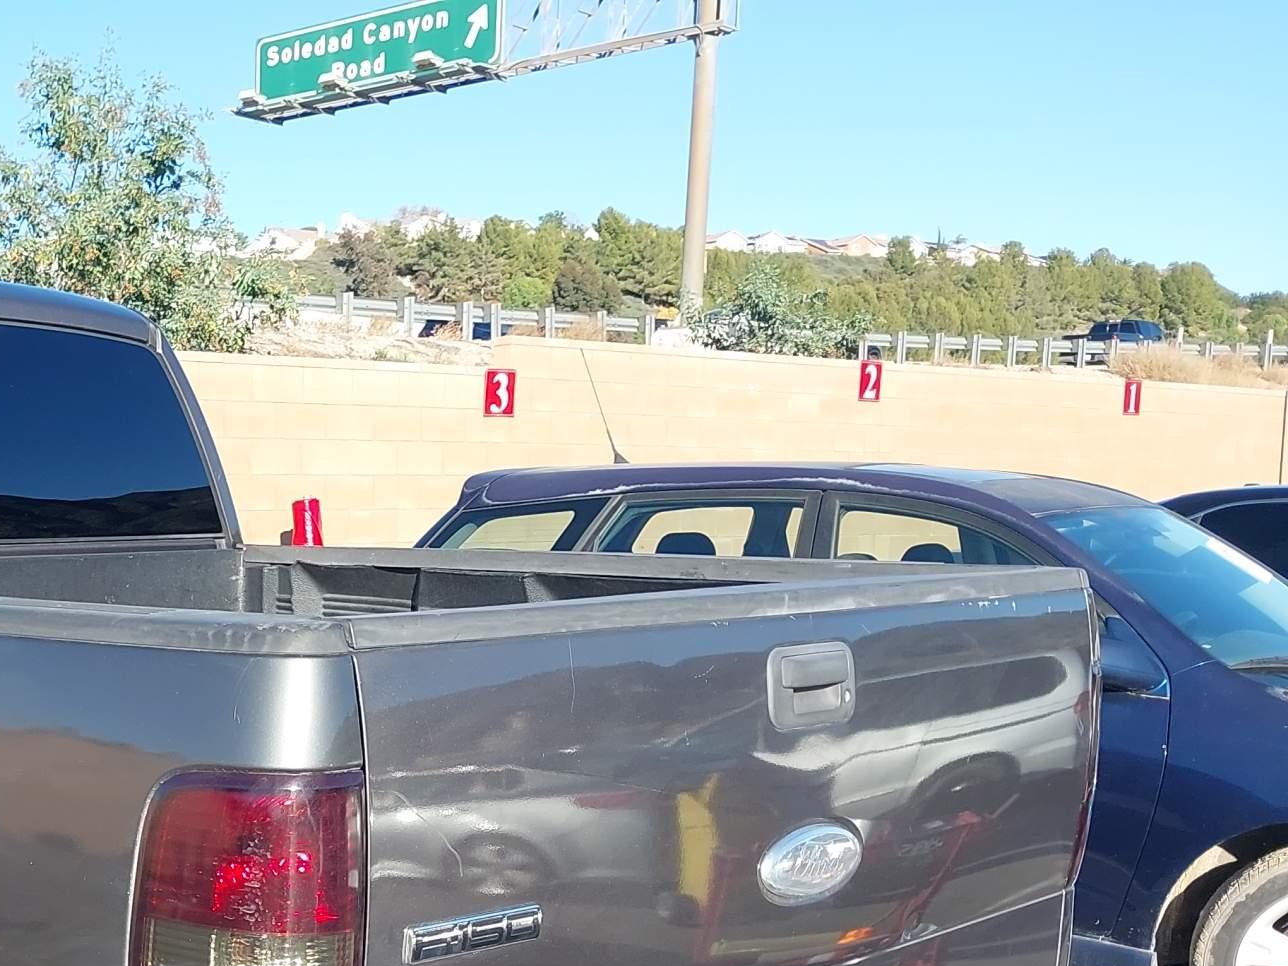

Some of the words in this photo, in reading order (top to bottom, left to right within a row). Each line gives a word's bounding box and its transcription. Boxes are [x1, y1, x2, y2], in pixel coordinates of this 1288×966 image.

[266, 28, 353, 67] Soledad
[363, 10, 449, 43] Canyon
[331, 52, 386, 80] Road
[489, 372, 509, 414] 3
[862, 364, 878, 400] 2
[1127, 382, 1138, 414] 1
